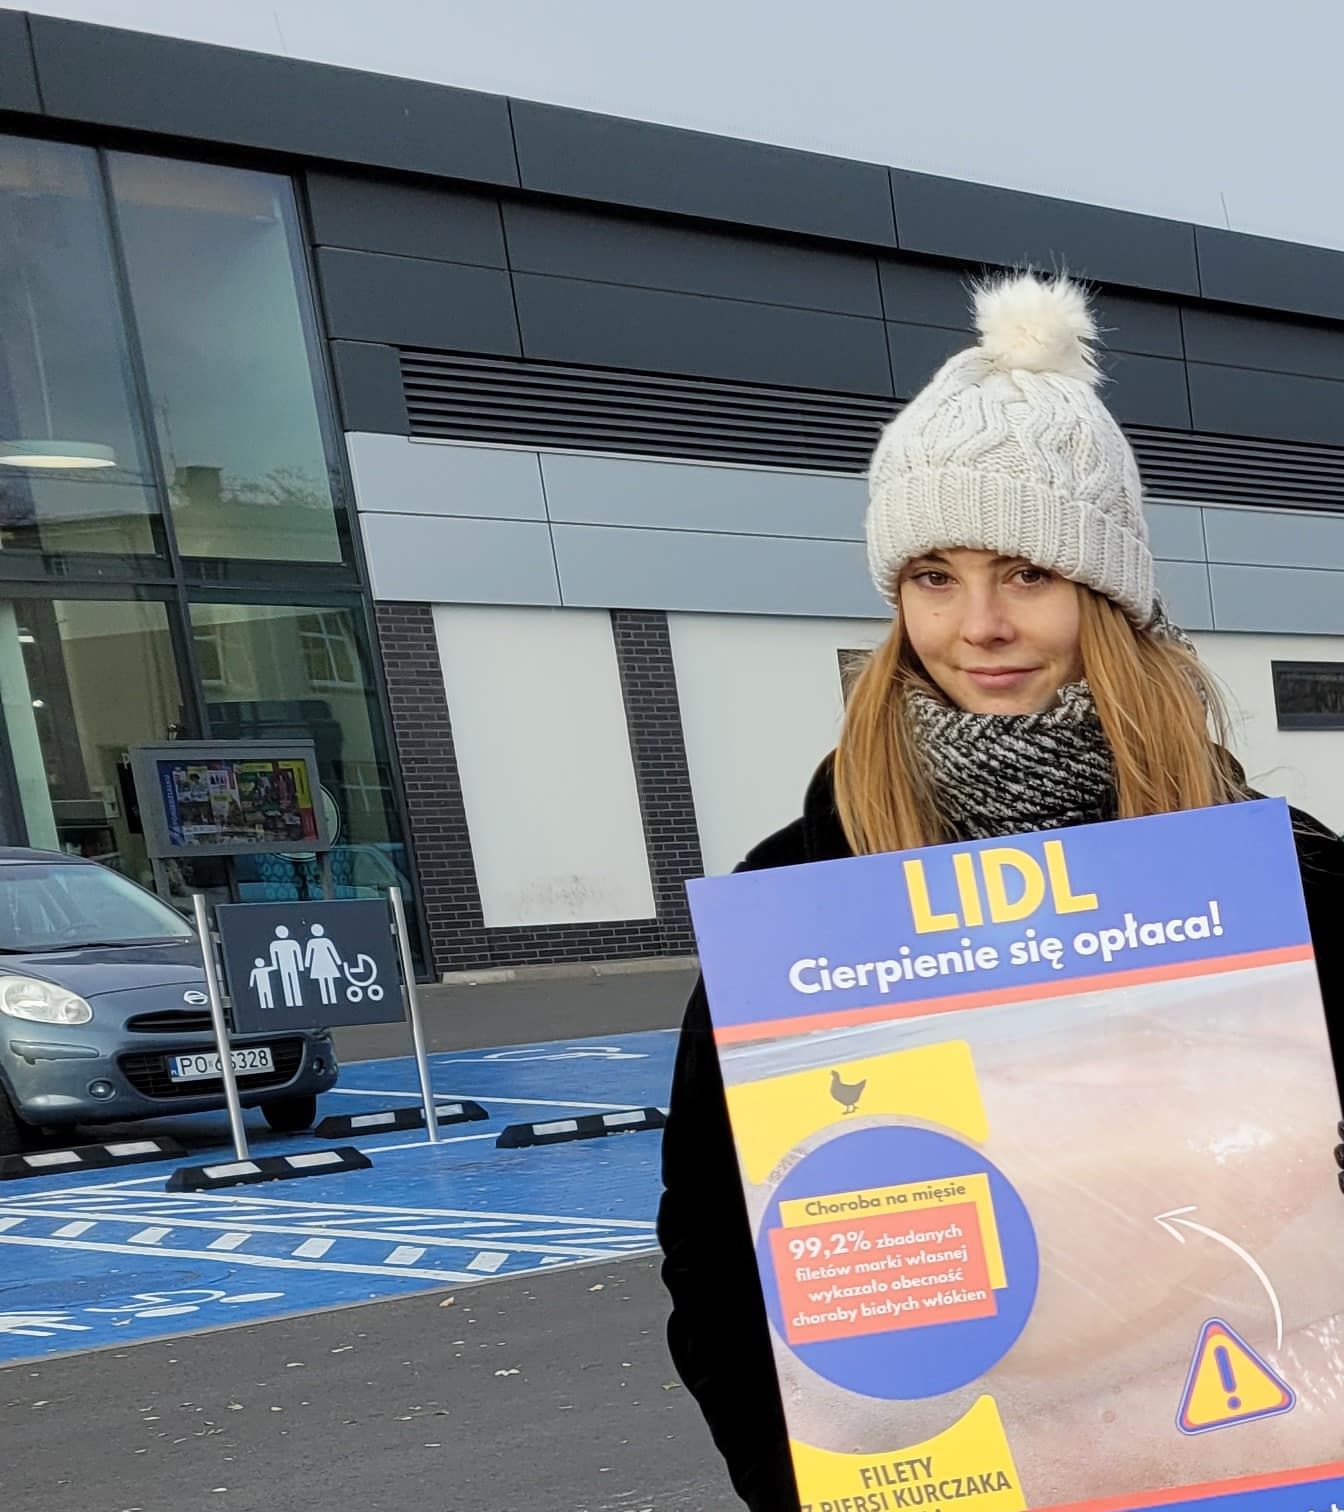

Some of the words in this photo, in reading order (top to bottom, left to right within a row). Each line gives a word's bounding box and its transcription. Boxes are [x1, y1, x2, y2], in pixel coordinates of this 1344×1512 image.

[903, 839, 1098, 934] LIDL
[789, 938, 999, 994] Cierpienie
[1009, 928, 1065, 969] się
[1073, 901, 1224, 962] opłaca!
[179, 1056, 208, 1075] PO
[804, 1195, 881, 1217] Choroba
[886, 1193, 909, 1206] na
[912, 1183, 967, 1203] mięsie
[789, 1231, 872, 1261] 99,2%
[875, 1224, 963, 1249] zbadanych
[796, 1263, 851, 1283] filetów
[855, 1255, 902, 1274] marki
[906, 1245, 968, 1267] własnej
[808, 1279, 888, 1304] wykazało
[891, 1267, 964, 1290] obecność
[792, 1306, 858, 1328] choroby
[861, 1298, 919, 1318] białych
[923, 1288, 987, 1308] włókien
[859, 1456, 934, 1489] FILETY
[894, 1470, 1013, 1509] KURCZAKA
